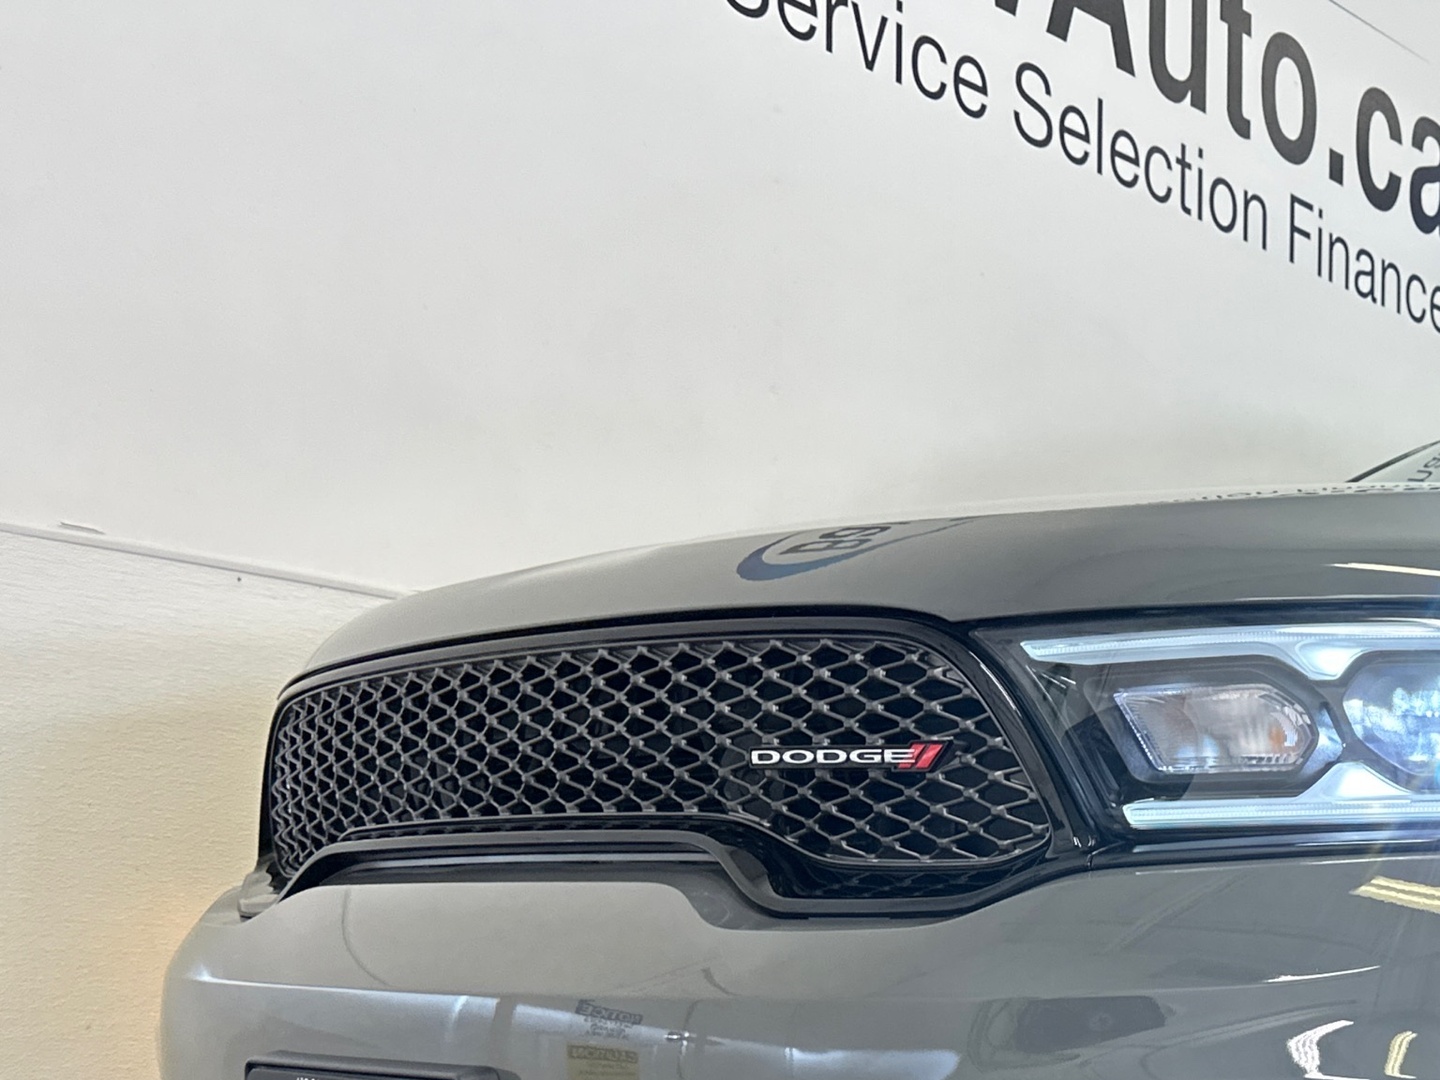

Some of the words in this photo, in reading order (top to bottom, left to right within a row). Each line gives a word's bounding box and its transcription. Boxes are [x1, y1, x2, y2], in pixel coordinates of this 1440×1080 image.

[726, 0, 989, 119] ervice
[1013, 61, 1268, 252] Selection
[751, 748, 916, 765] DODGE
